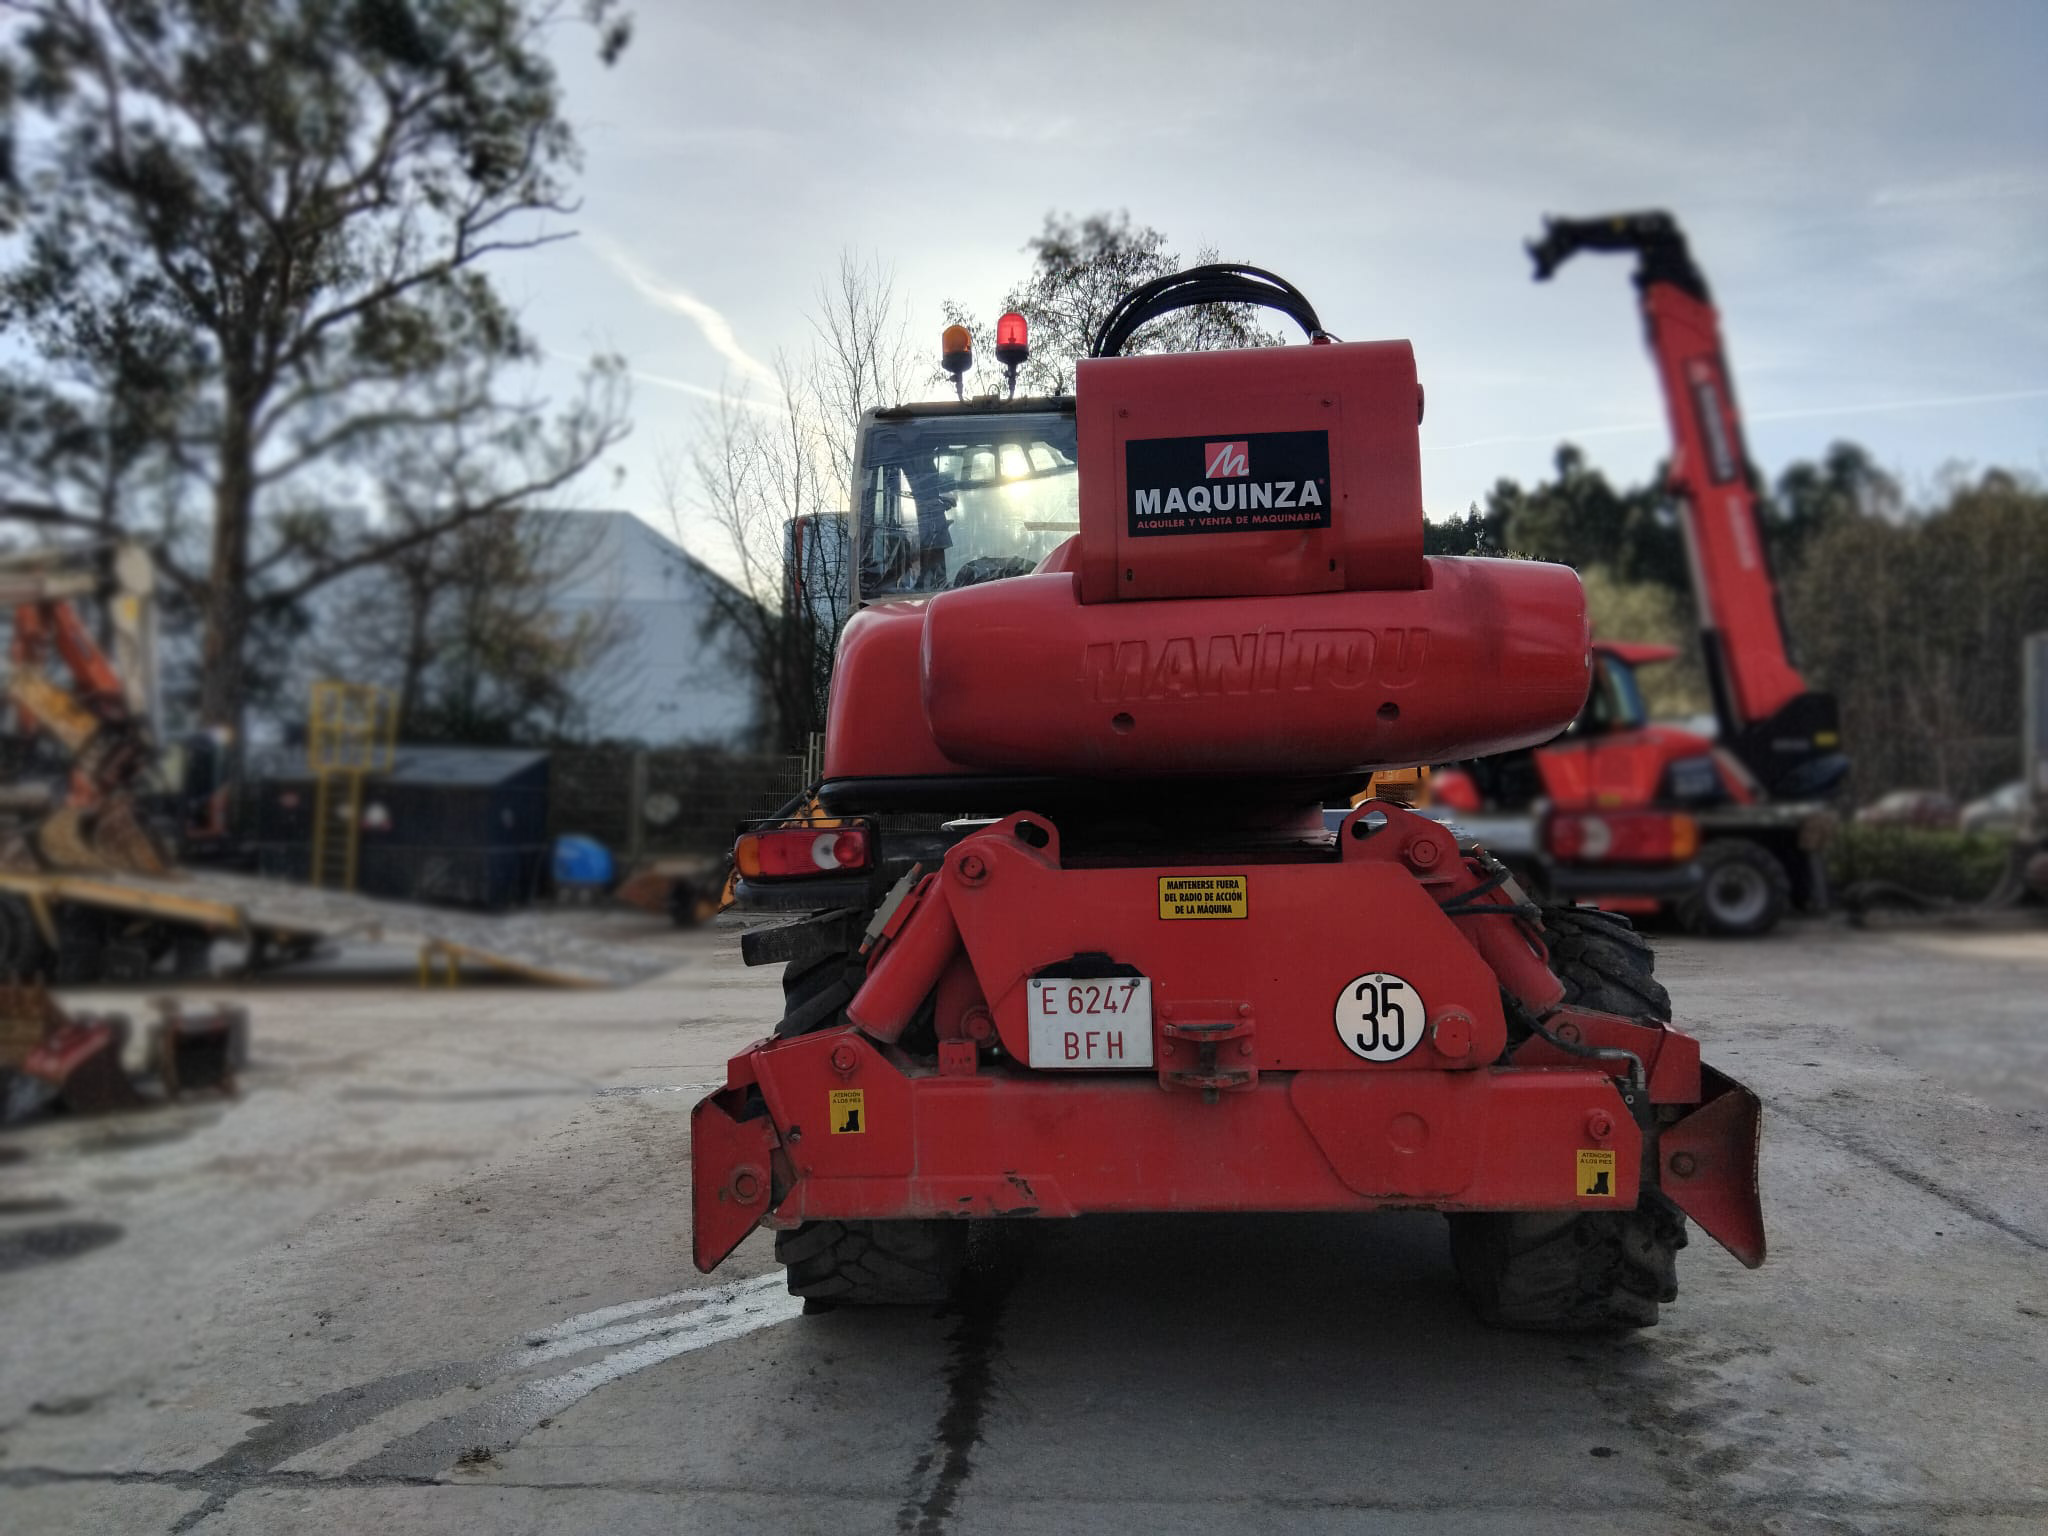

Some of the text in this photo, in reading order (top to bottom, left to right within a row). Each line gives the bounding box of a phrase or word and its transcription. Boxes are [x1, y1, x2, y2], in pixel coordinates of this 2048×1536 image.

[1135, 480, 1322, 515] MAQUINZA
[1137, 512, 1321, 529] ALQUILER Y VENTA DE MAQUINARIA
[1083, 628, 1431, 702] MANITOU
[1165, 893, 1177, 902] DEL
[1180, 892, 1202, 902] RADIO
[1204, 892, 1214, 902] DE
[1167, 880, 1239, 890] MANTENERSE FUERA
[1175, 905, 1184, 914] DE
[1186, 905, 1195, 914] LA
[1042, 986, 1136, 1014] E 6247
[1356, 983, 1404, 1051] 35
[1064, 1031, 1123, 1060] BFH
